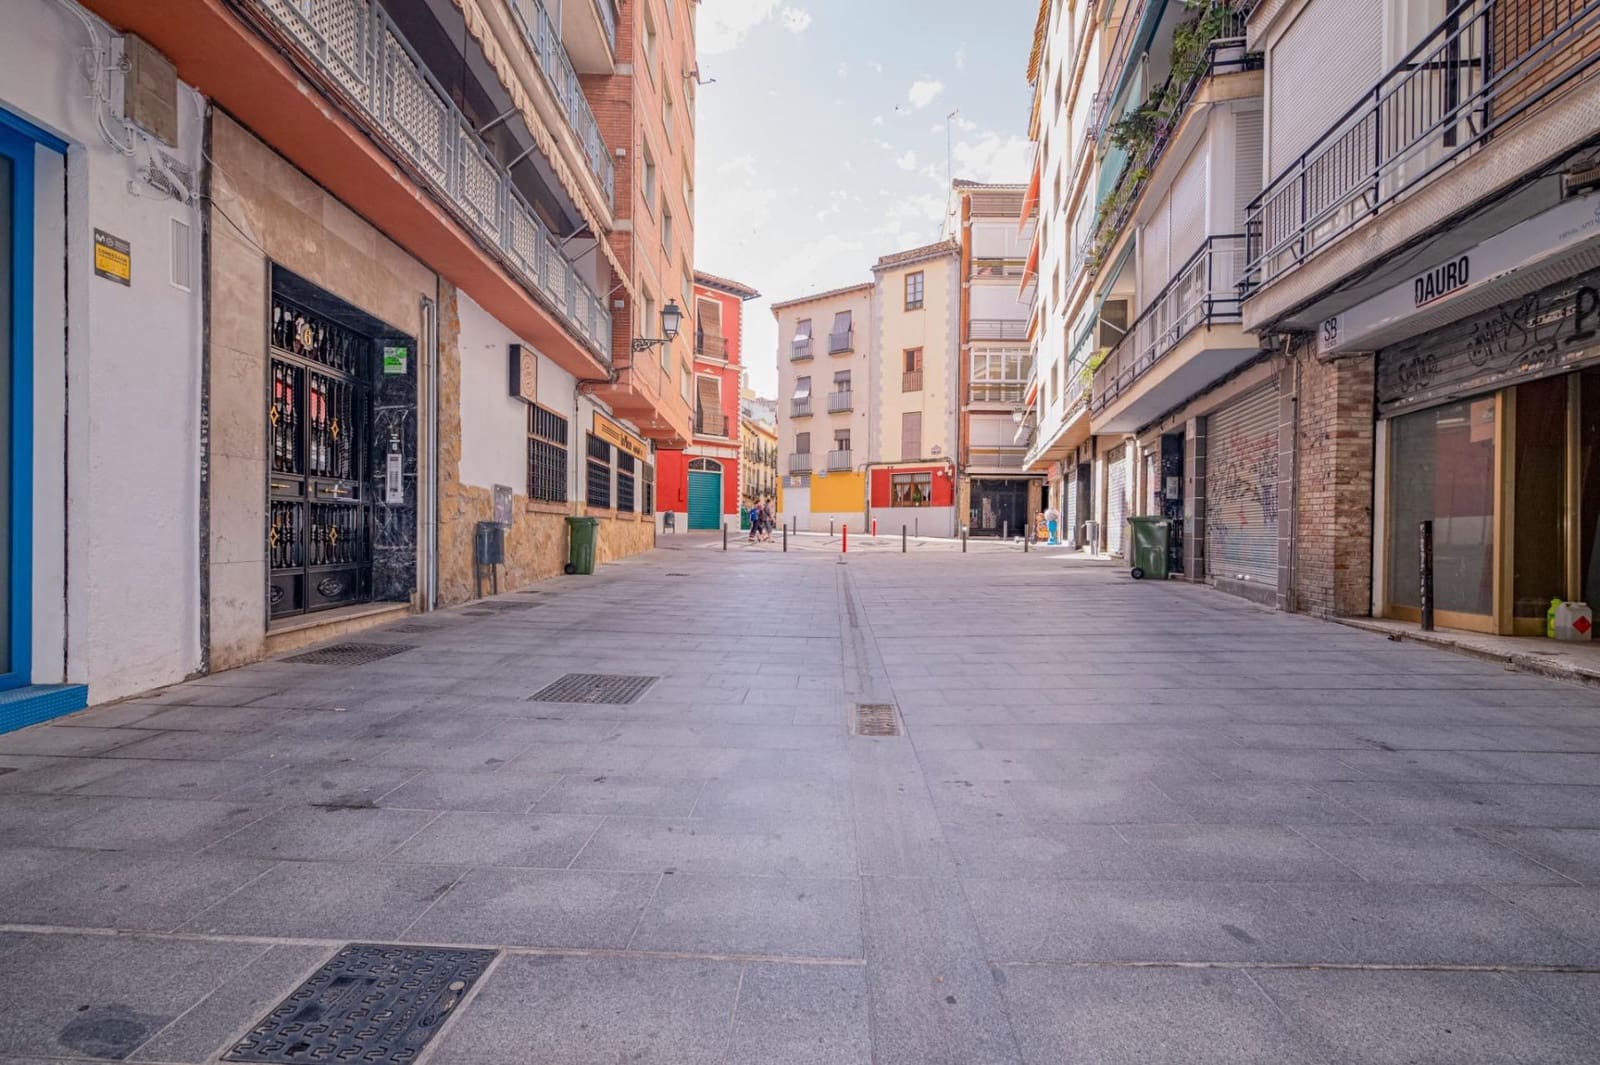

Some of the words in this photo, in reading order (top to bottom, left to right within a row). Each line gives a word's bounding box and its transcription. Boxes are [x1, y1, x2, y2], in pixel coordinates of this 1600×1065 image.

[1414, 255, 1470, 305] DAURO
[303, 328, 312, 346] 6
[1324, 317, 1337, 341] SB
